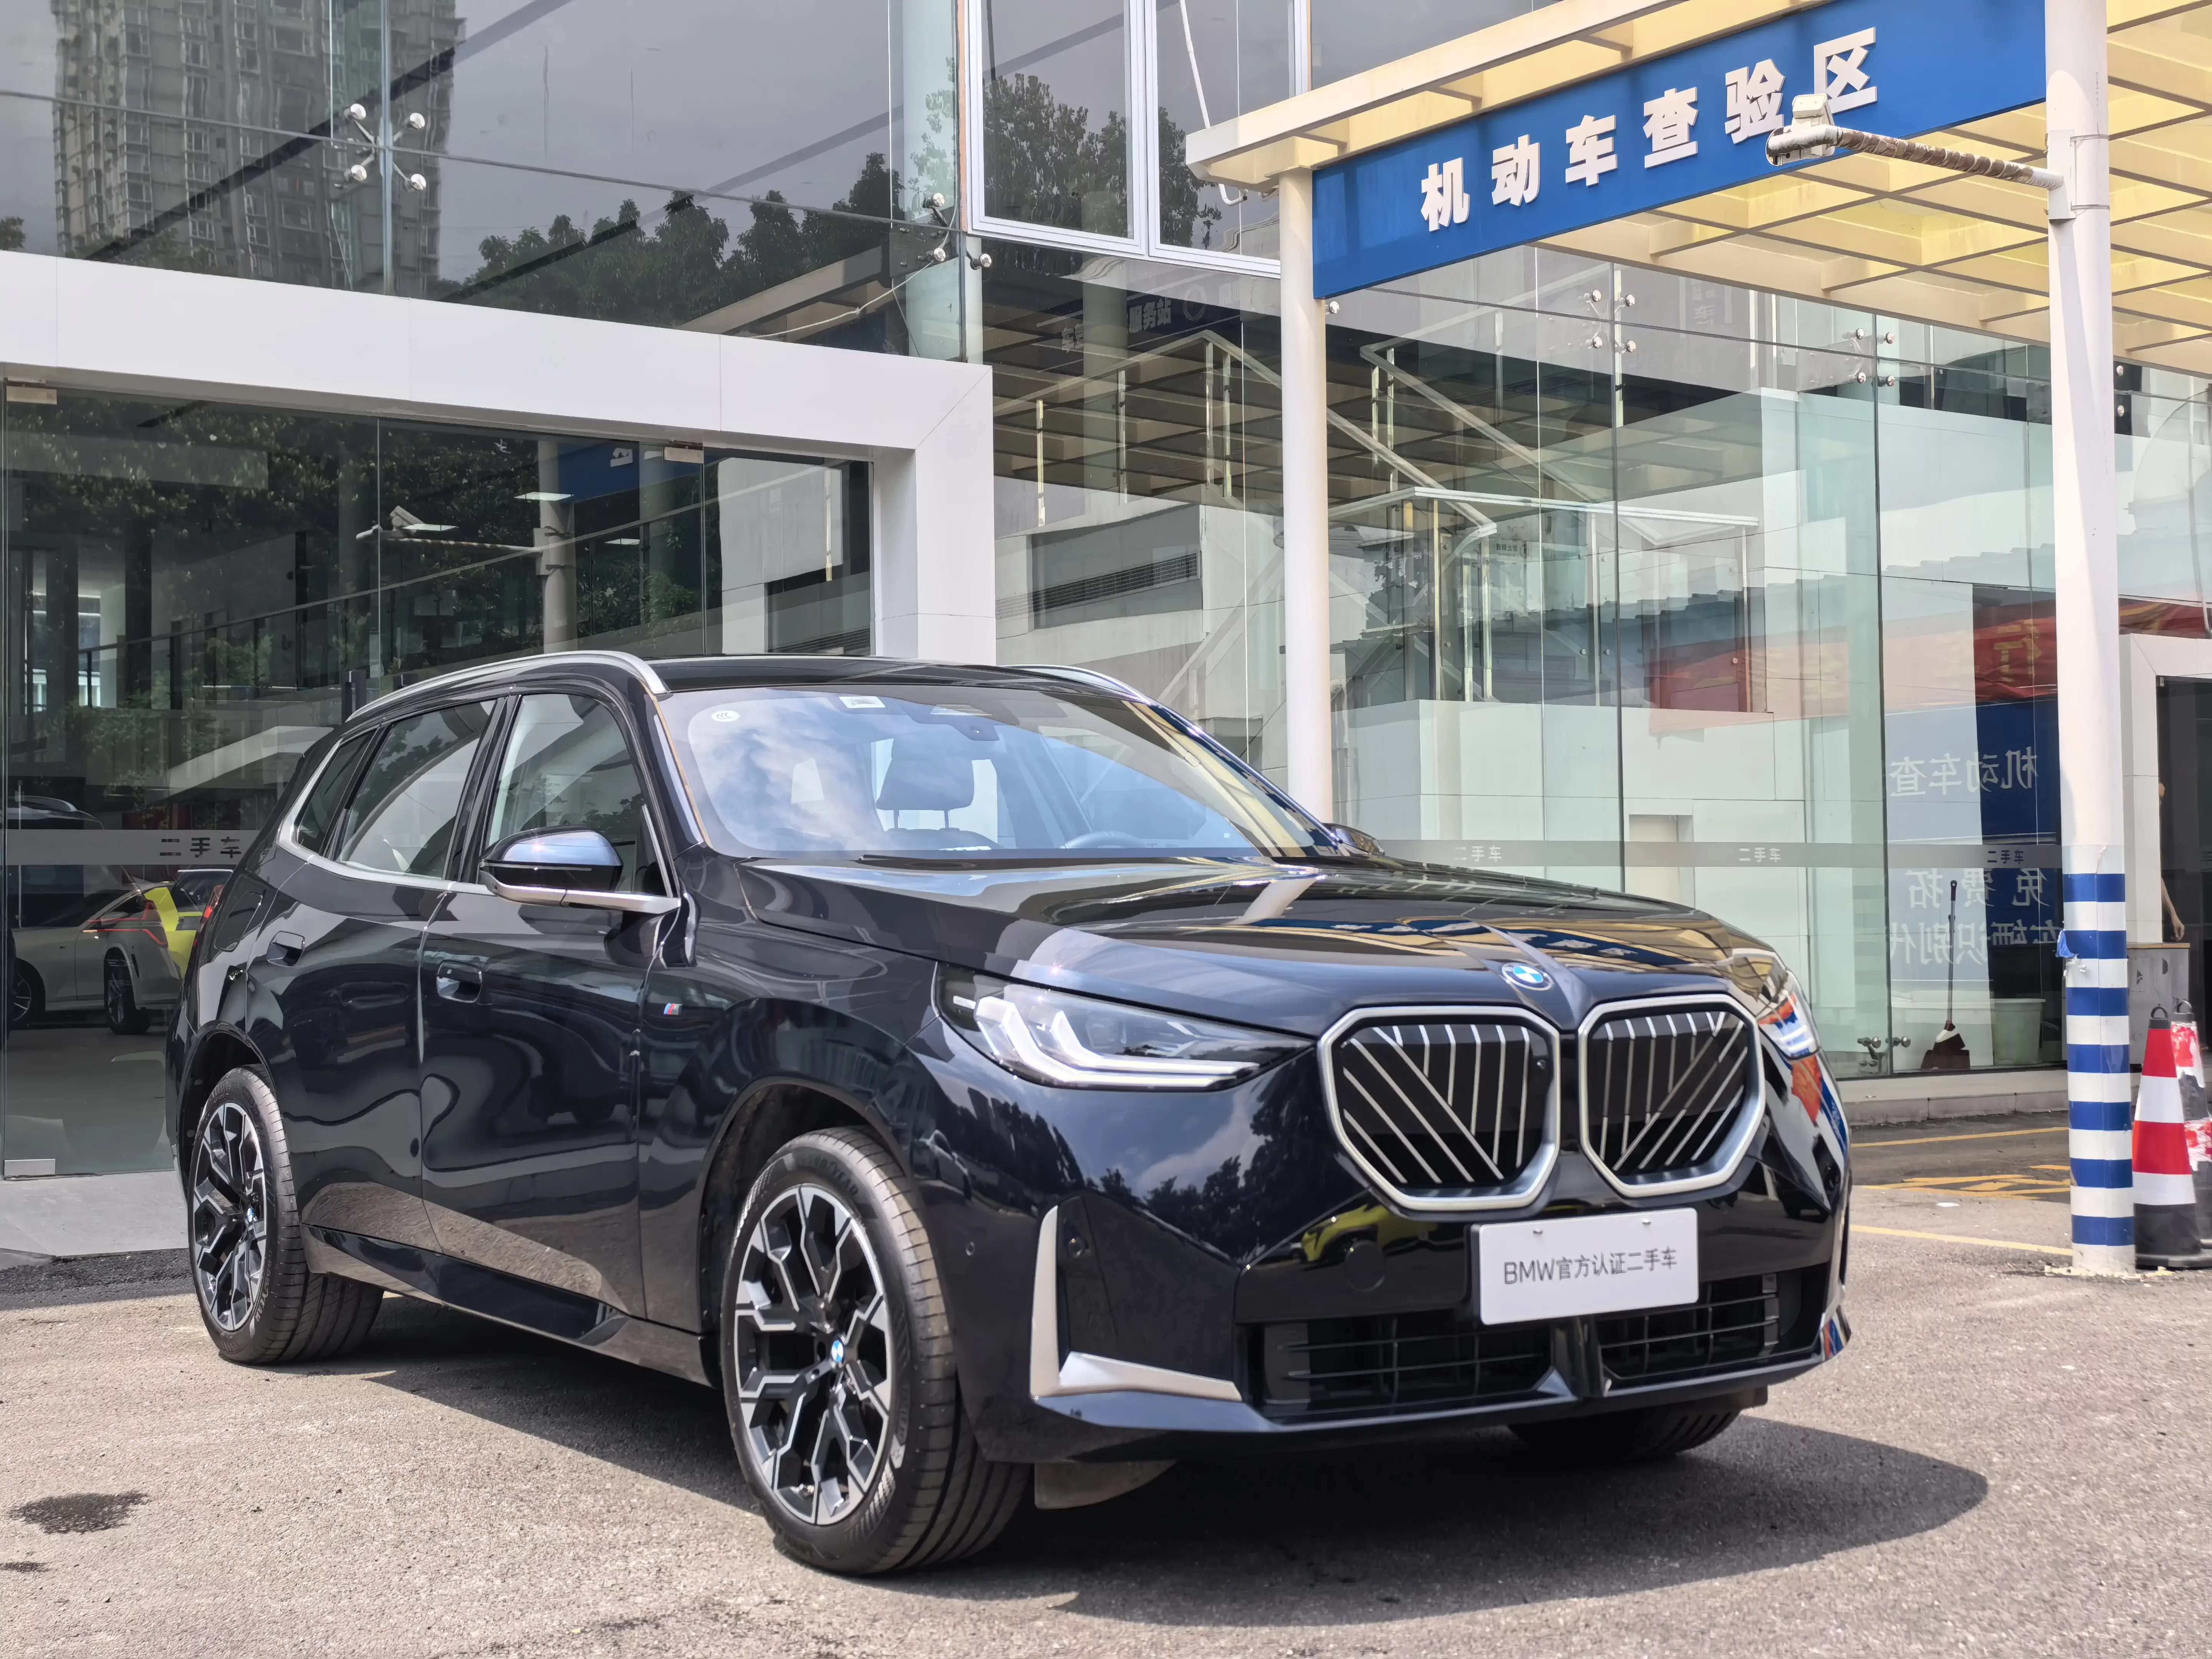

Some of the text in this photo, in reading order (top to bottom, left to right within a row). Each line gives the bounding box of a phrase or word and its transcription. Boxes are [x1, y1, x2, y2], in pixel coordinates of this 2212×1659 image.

[1420, 26, 1878, 232] 机动车查验区
[159, 836, 242, 859] 二手车
[1454, 845, 1502, 863] 二手车
[1739, 847, 1782, 863] 二手车
[1987, 849, 2025, 865] 二手车
[1503, 1245, 1678, 1285] BMW官方认证二手车
